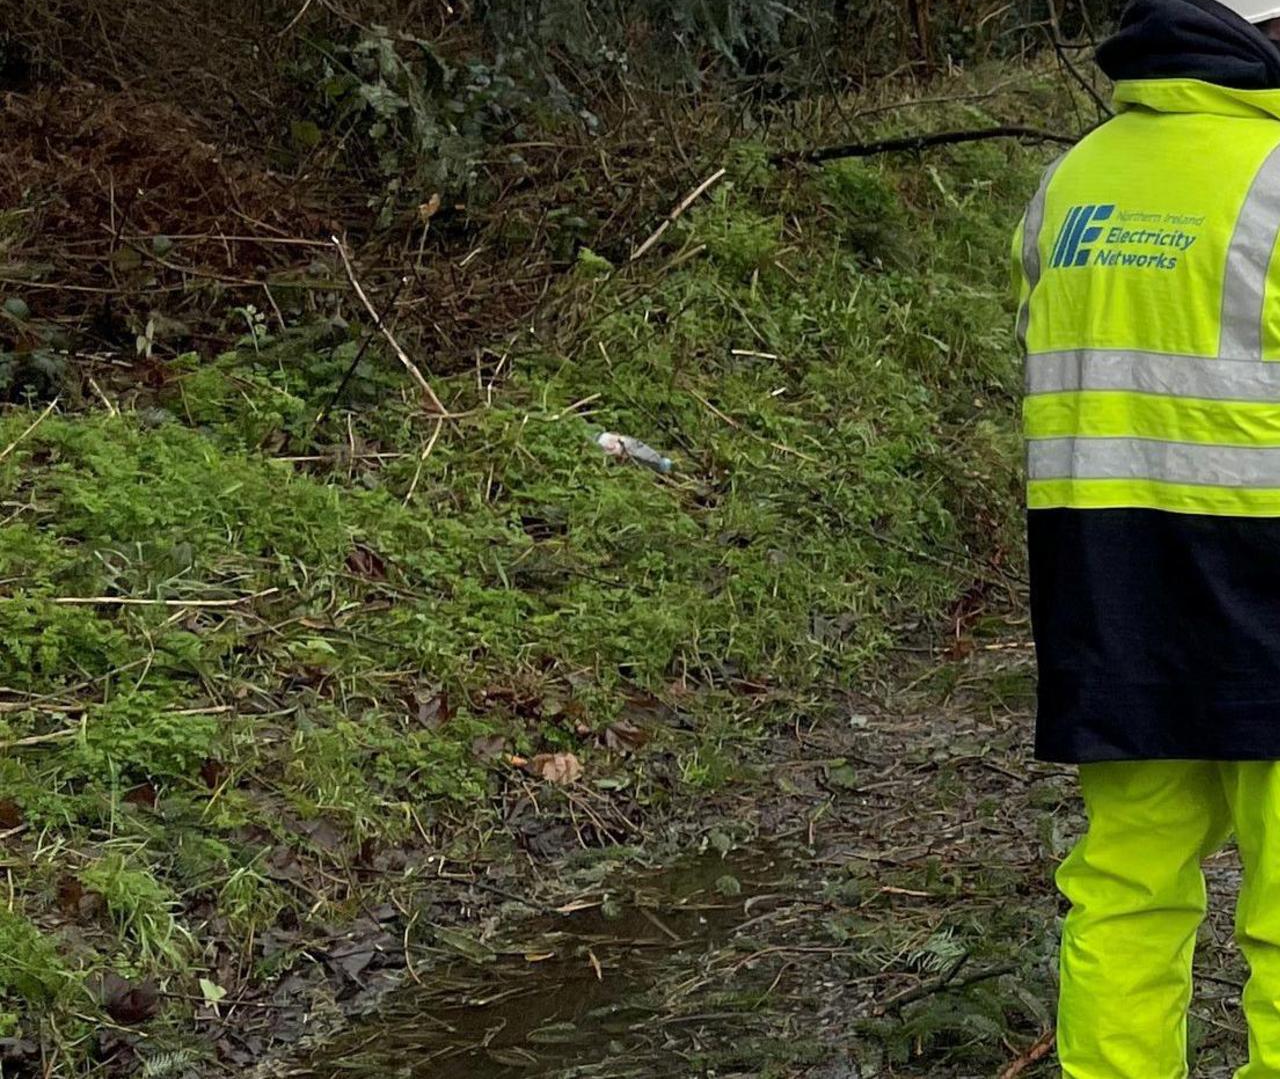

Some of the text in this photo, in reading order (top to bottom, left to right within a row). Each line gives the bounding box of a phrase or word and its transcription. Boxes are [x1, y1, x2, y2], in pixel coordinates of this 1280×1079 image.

[1118, 209, 1205, 226] Northern Ireland
[1106, 227, 1196, 251] Electricity
[1094, 249, 1177, 269] Networks
